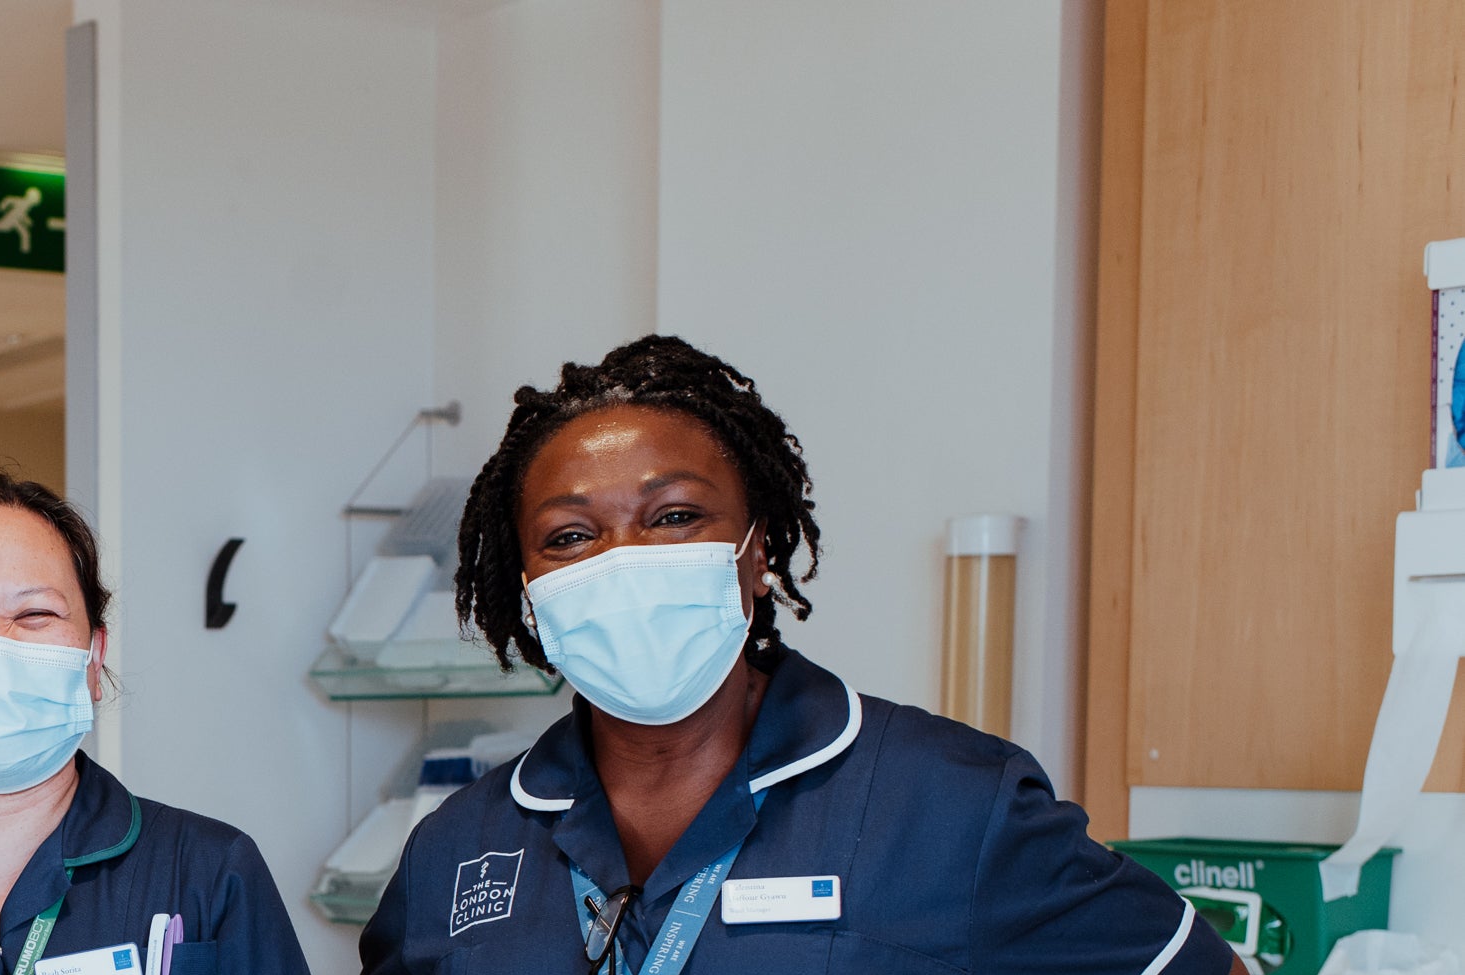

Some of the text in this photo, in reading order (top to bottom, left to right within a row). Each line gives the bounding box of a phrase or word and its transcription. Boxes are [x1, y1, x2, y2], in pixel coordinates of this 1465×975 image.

[473, 880, 491, 891] THE
[707, 863, 723, 884] WE ARE
[1174, 859, 1255, 889] clinell
[454, 887, 514, 913] LONDON
[455, 901, 505, 925] CLINIC
[649, 921, 683, 975] INSPIRING
[670, 940, 686, 961] WE ARE
